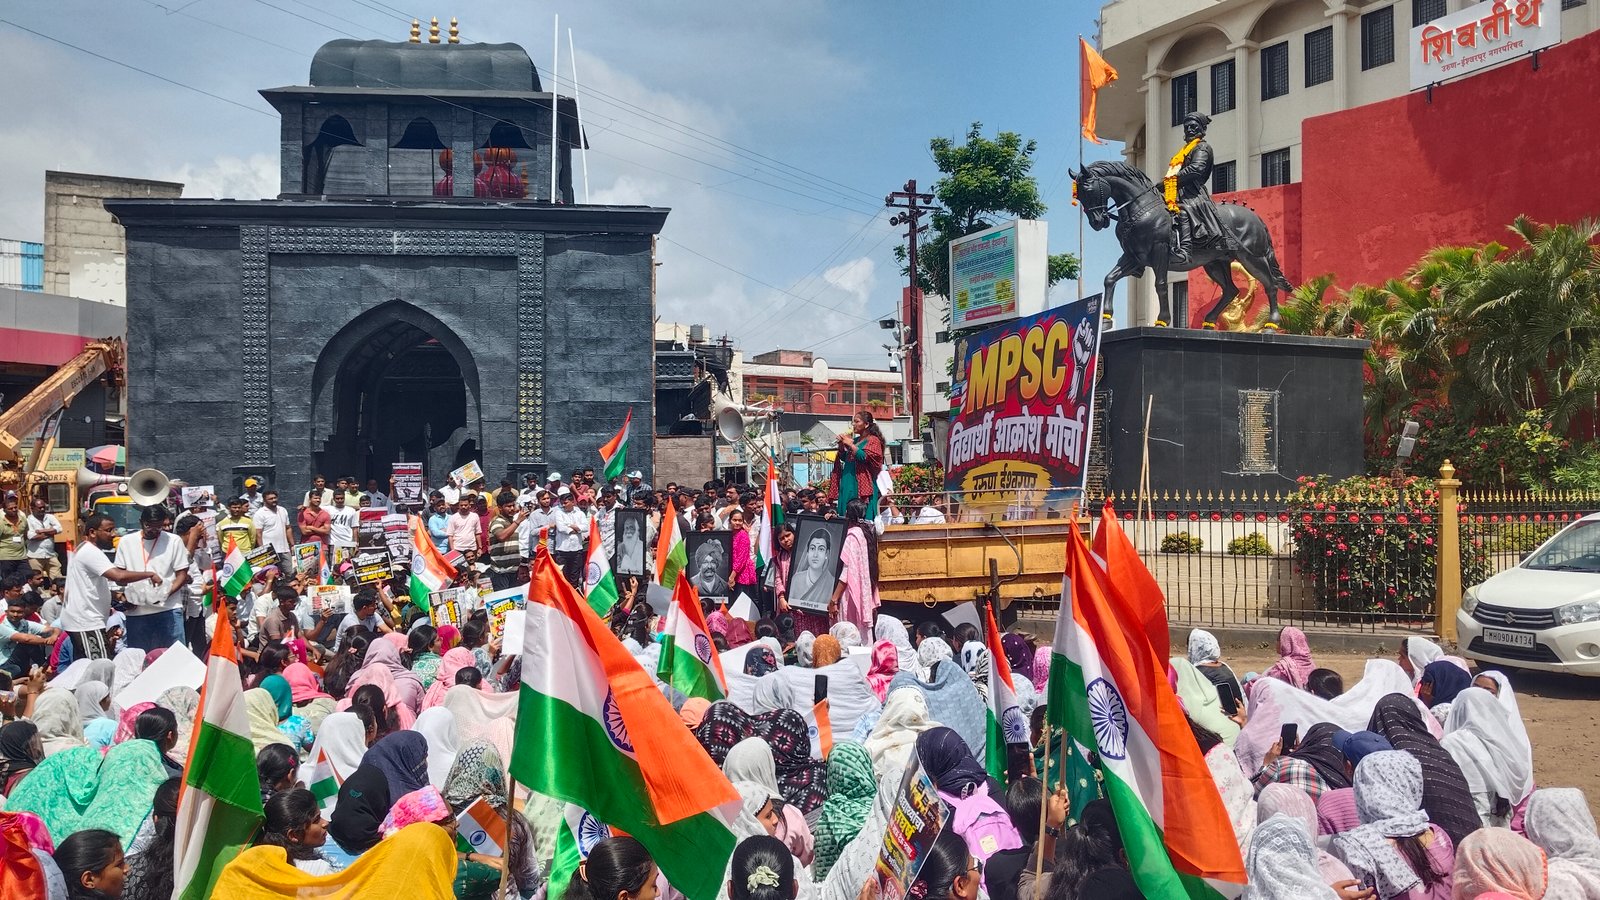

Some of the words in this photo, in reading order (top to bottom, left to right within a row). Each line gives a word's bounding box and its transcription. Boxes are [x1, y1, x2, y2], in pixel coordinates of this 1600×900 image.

[967, 320, 1068, 414] MPSC
[949, 406, 994, 467] विद्यार्थी
[993, 404, 1044, 454] आक्रोश
[1045, 404, 1086, 467] मोर्चा
[1488, 632, 1532, 646] MH09DA4134
